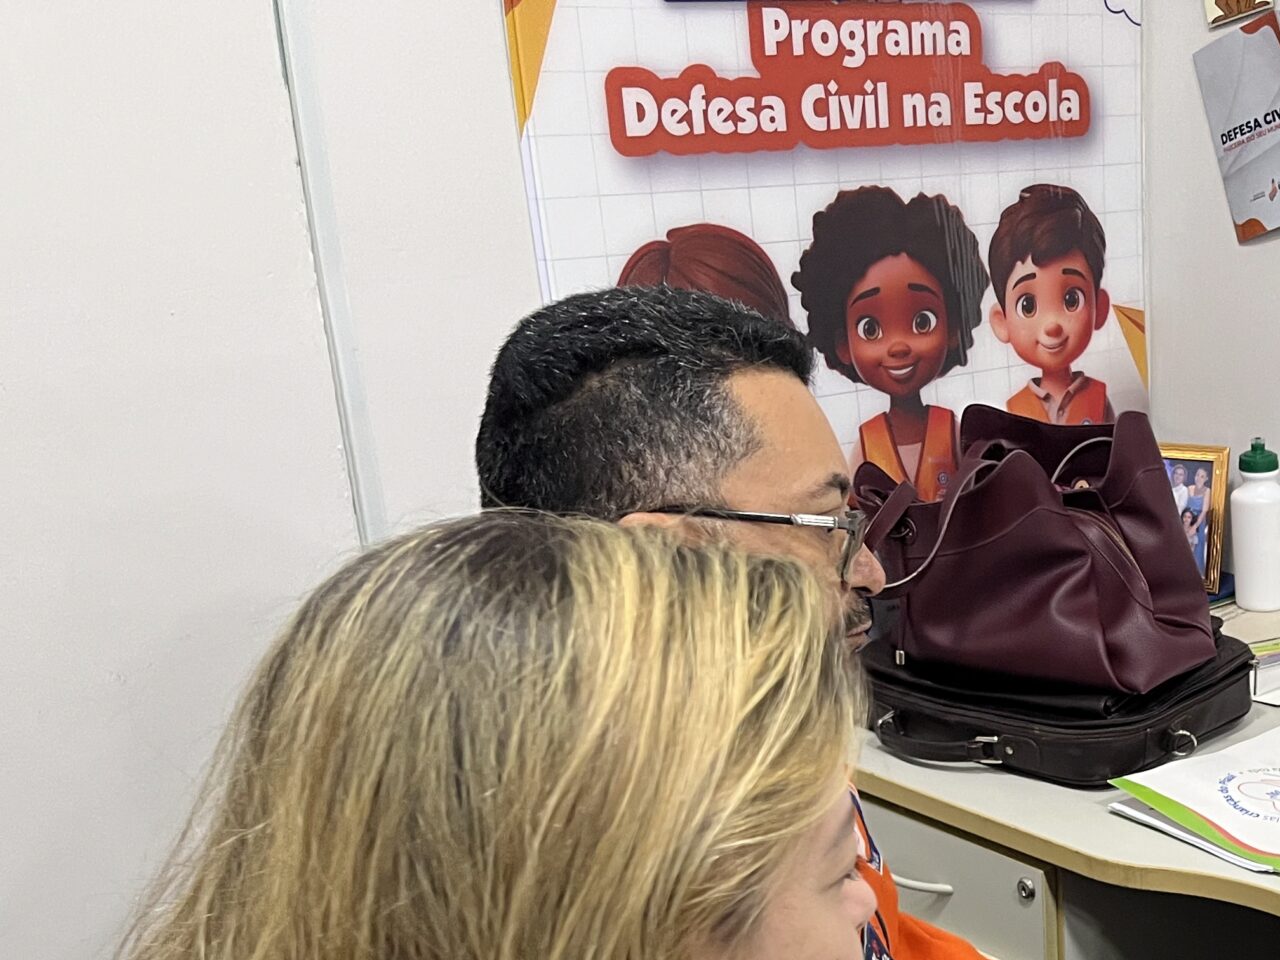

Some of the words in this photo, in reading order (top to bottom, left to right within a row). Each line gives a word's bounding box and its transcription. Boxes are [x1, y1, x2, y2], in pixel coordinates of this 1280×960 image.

[761, 6, 971, 69] Programa
[621, 84, 787, 137] Defesa
[800, 79, 889, 131] Civil
[903, 91, 952, 128] na
[964, 79, 1080, 126] Escola
[1220, 117, 1262, 145] DEFESA
